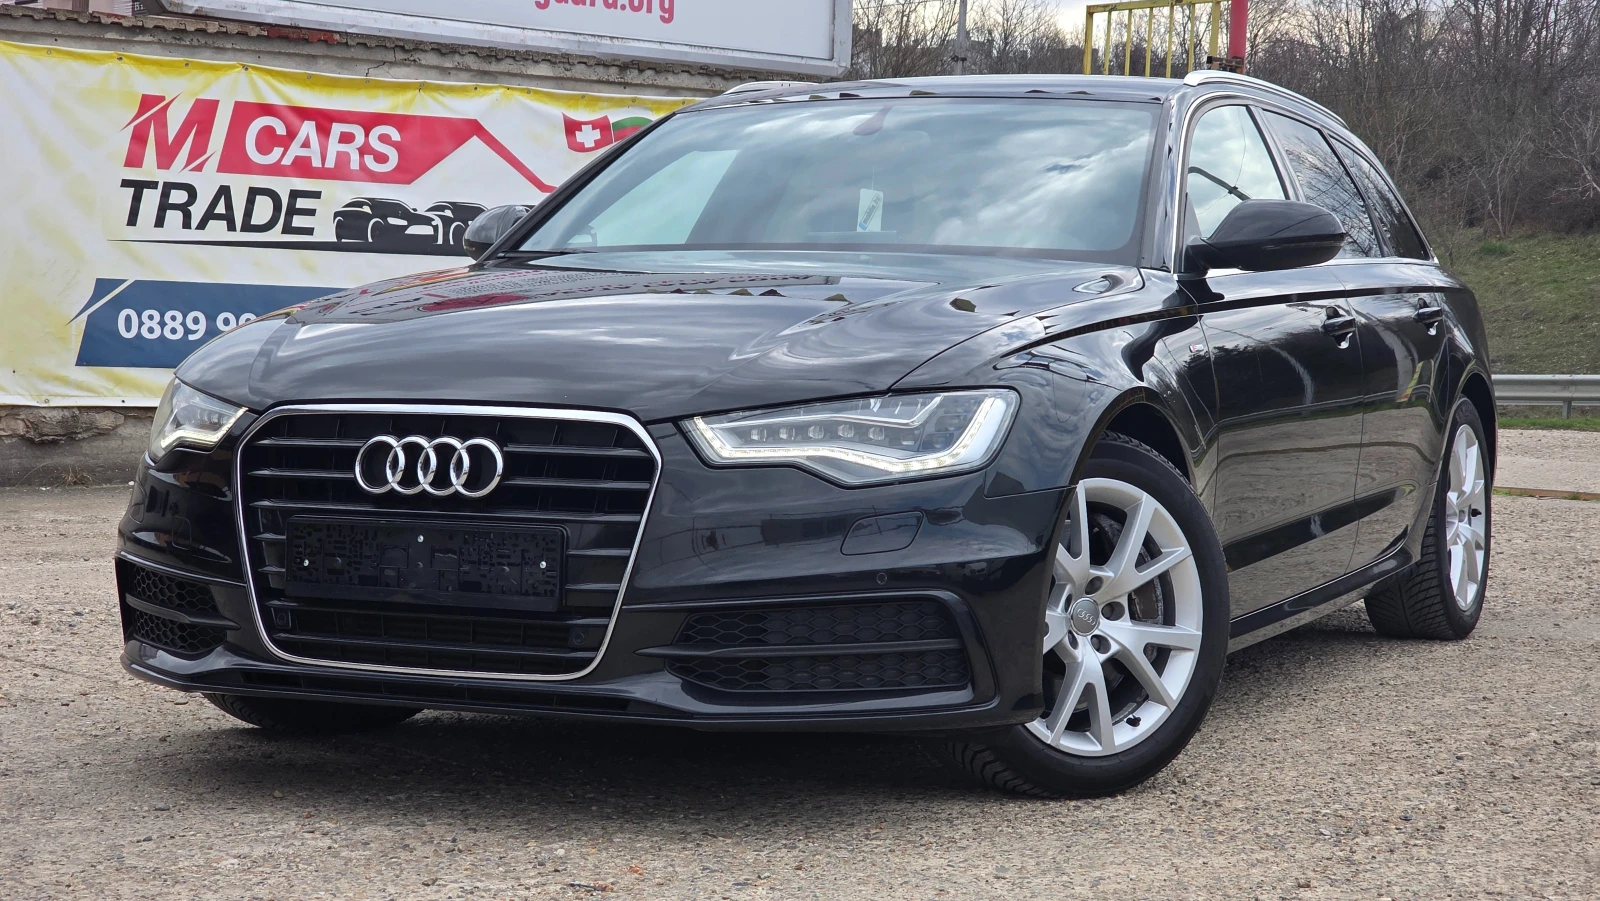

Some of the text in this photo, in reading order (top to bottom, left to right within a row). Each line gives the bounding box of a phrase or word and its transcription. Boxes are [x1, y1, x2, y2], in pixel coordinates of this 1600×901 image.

[120, 93, 401, 173] M CARS
[120, 178, 323, 236] TRADE
[117, 308, 207, 341] 0889
